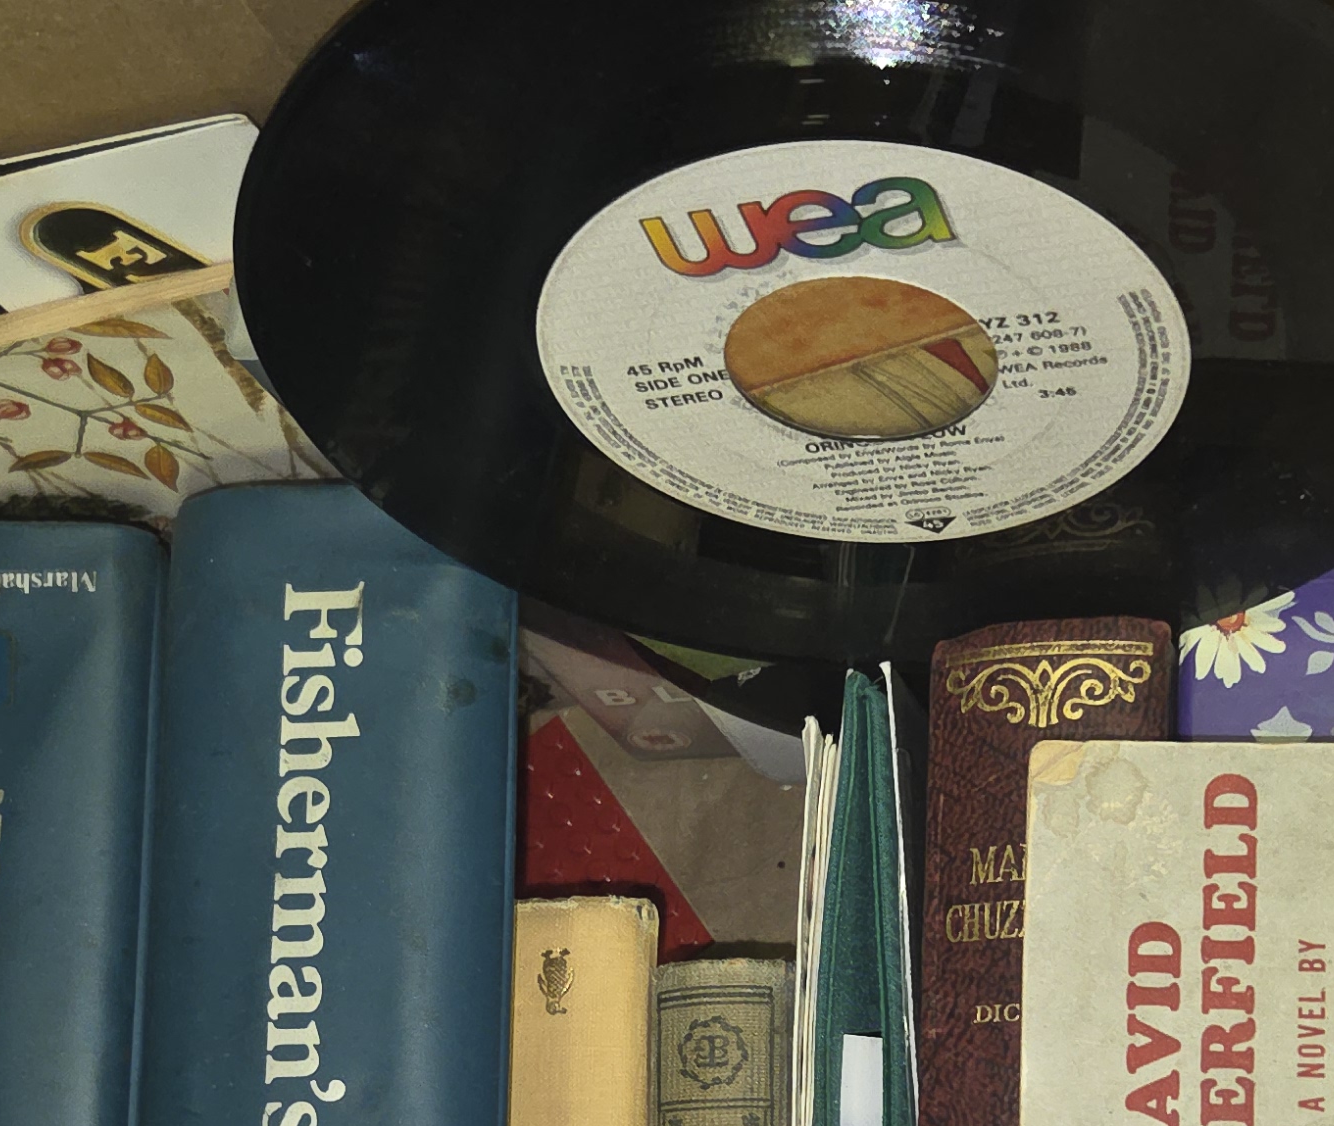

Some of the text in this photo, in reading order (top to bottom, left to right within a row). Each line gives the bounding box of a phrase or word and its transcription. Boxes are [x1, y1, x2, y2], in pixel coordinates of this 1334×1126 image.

[639, 176, 958, 277] wea
[75, 229, 167, 284] F
[1016, 311, 1061, 327] 312
[627, 356, 704, 377] 45 RpM
[998, 356, 1108, 374] WEA Records
[635, 369, 731, 393] SIDE ONE
[645, 389, 724, 410] STEREO
[945, 900, 1027, 943] CHUZ
[1297, 939, 1327, 1113] A NOVEL BY
